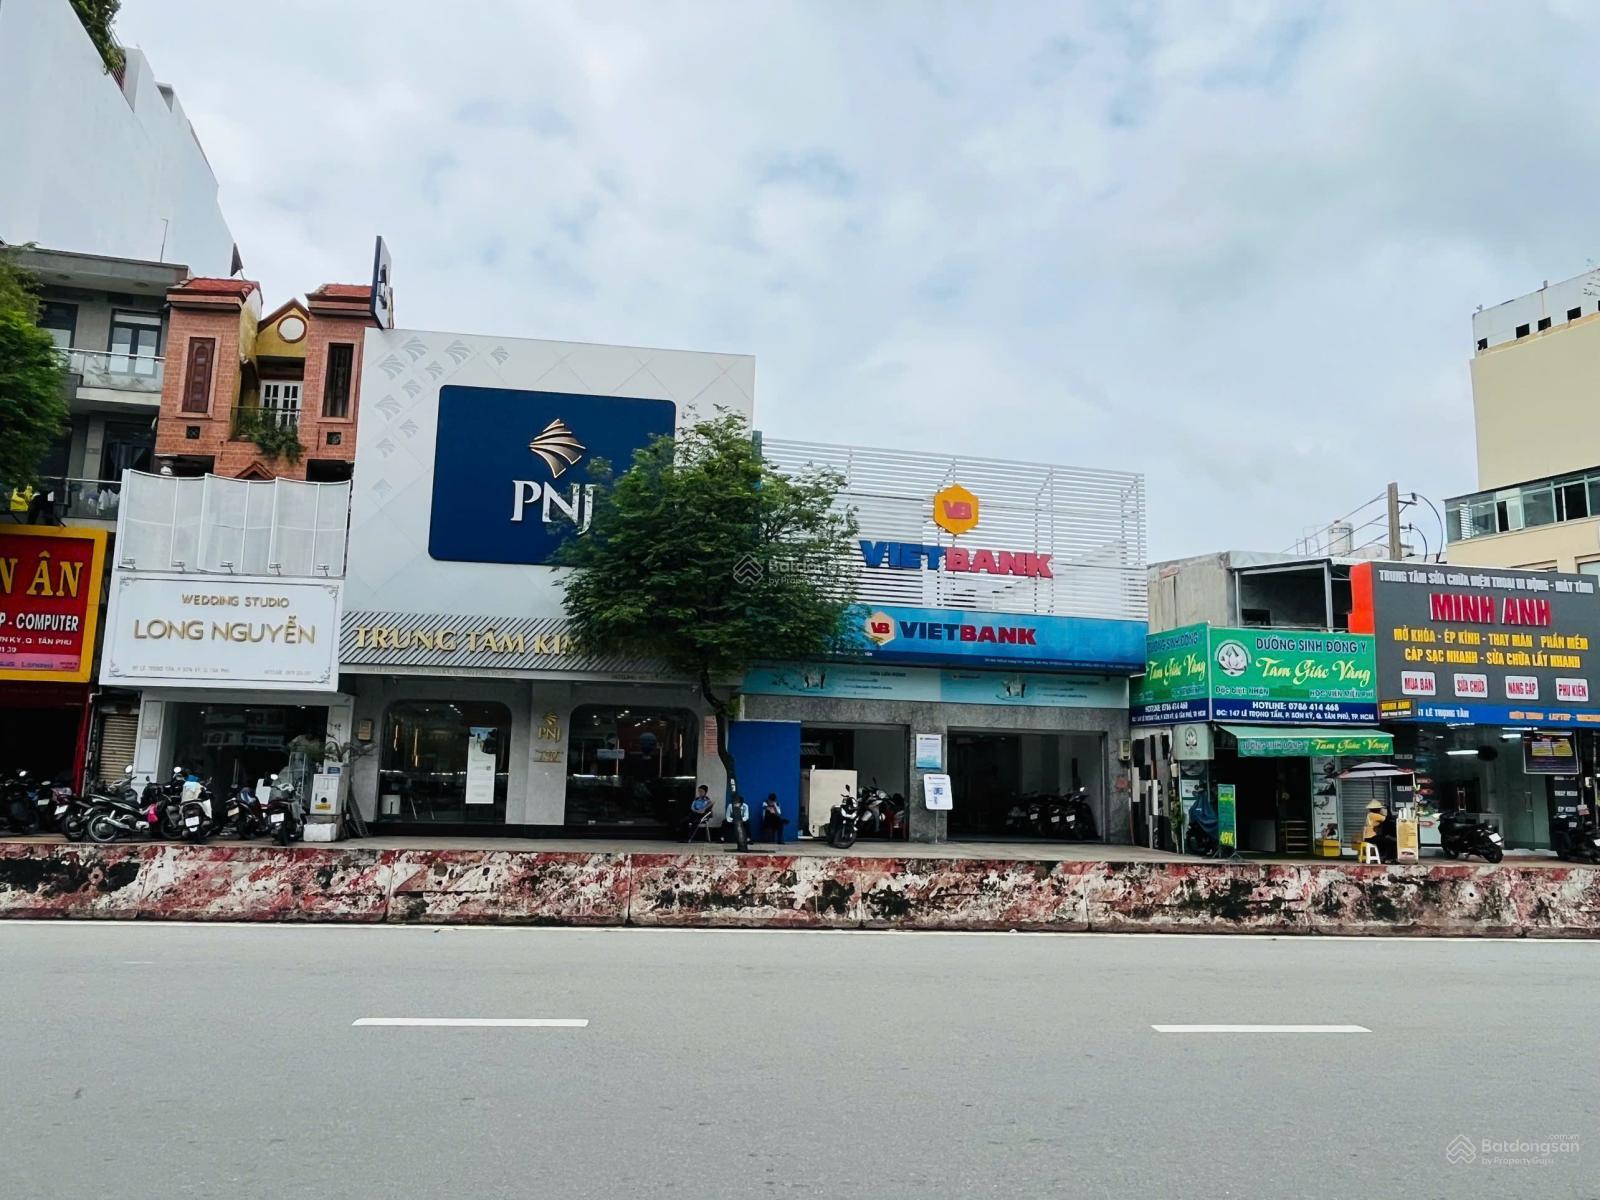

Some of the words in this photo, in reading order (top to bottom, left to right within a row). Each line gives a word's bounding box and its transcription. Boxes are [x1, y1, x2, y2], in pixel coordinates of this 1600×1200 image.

[510, 480, 597, 535] PNJ
[859, 540, 1053, 578] VIETBANK
[26, 550, 83, 598] ÂN
[182, 594, 240, 607] WEDDING
[245, 597, 290, 608] STUDIO
[1429, 593, 1496, 624] MINH
[1501, 597, 1552, 627] ANH
[16, 612, 79, 631] COMPUTER
[133, 619, 204, 640] LONG
[211, 615, 315, 644] NGUYỄN
[870, 622, 890, 634] VB
[355, 624, 458, 652] TRUNG
[466, 624, 526, 654] TÂM
[899, 621, 1036, 645] VIETBANK
[1256, 634, 1295, 651] DƯỠNG
[1299, 640, 1322, 652] SINH
[1326, 638, 1357, 653] ĐÔNG
[1488, 633, 1509, 646] THAY
[1426, 649, 1444, 664] SẠC
[1446, 650, 1478, 663] NHANH
[1486, 648, 1504, 665] SỬA
[1256, 657, 1290, 677] Tam
[1293, 659, 1329, 685] Giác
[1332, 660, 1370, 687] Vàng
[1309, 703, 1323, 711] 414
[537, 727, 561, 743] PNJ
